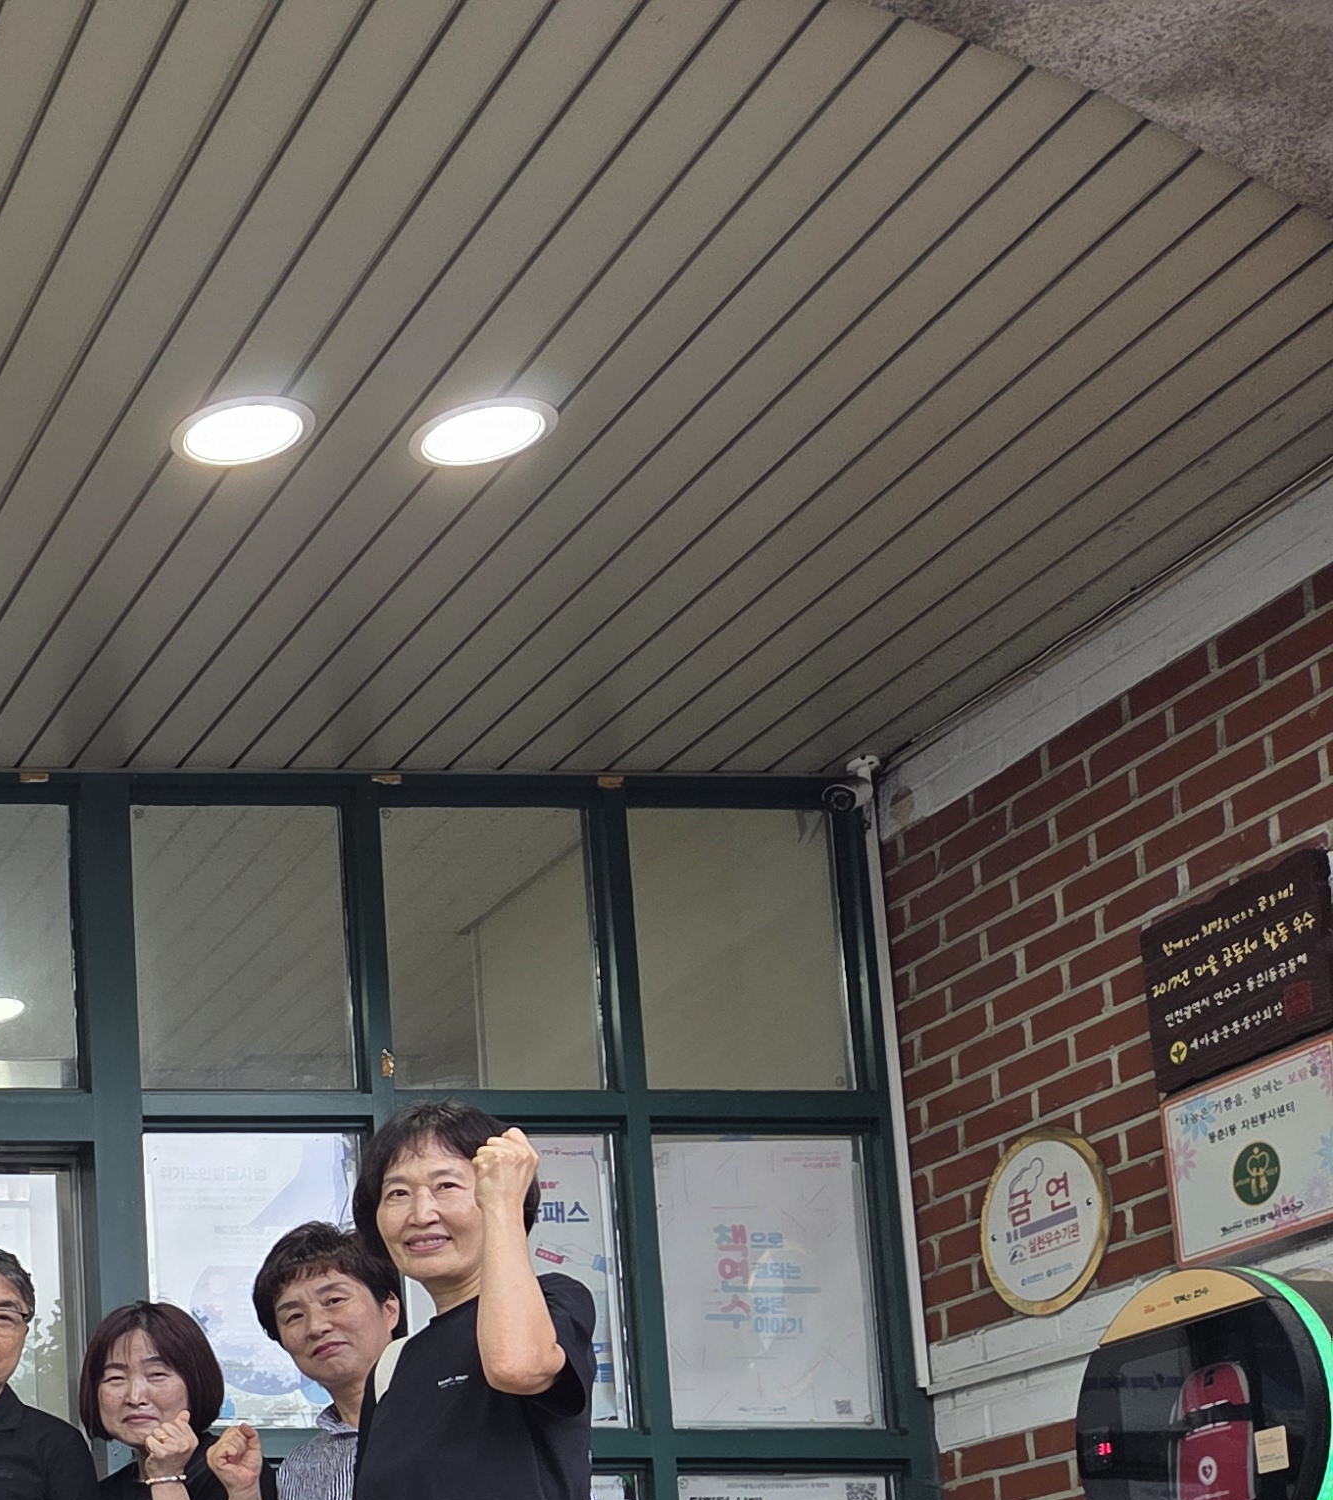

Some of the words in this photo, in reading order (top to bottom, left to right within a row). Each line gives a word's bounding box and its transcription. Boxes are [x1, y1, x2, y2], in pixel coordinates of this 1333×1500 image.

[1258, 882, 1294, 912] 공동체!
[1151, 969, 1190, 998] 2017년
[1195, 954, 1219, 976] 마을
[1222, 937, 1258, 967] 공동체
[1263, 921, 1289, 951] 활동
[1293, 912, 1316, 933] 우수
[1165, 996, 1210, 1028] 인천광역시
[1213, 982, 1242, 1006] 연수구
[1251, 1079, 1283, 1100] 참여는
[1208, 1124, 1236, 1144] 동춘1동
[1241, 1101, 1296, 1130] 자원봉사센터
[534, 1201, 590, 1223] 패스
[1029, 1222, 1080, 1253] 실천우수기관
[754, 1317, 803, 1334] 이야기
